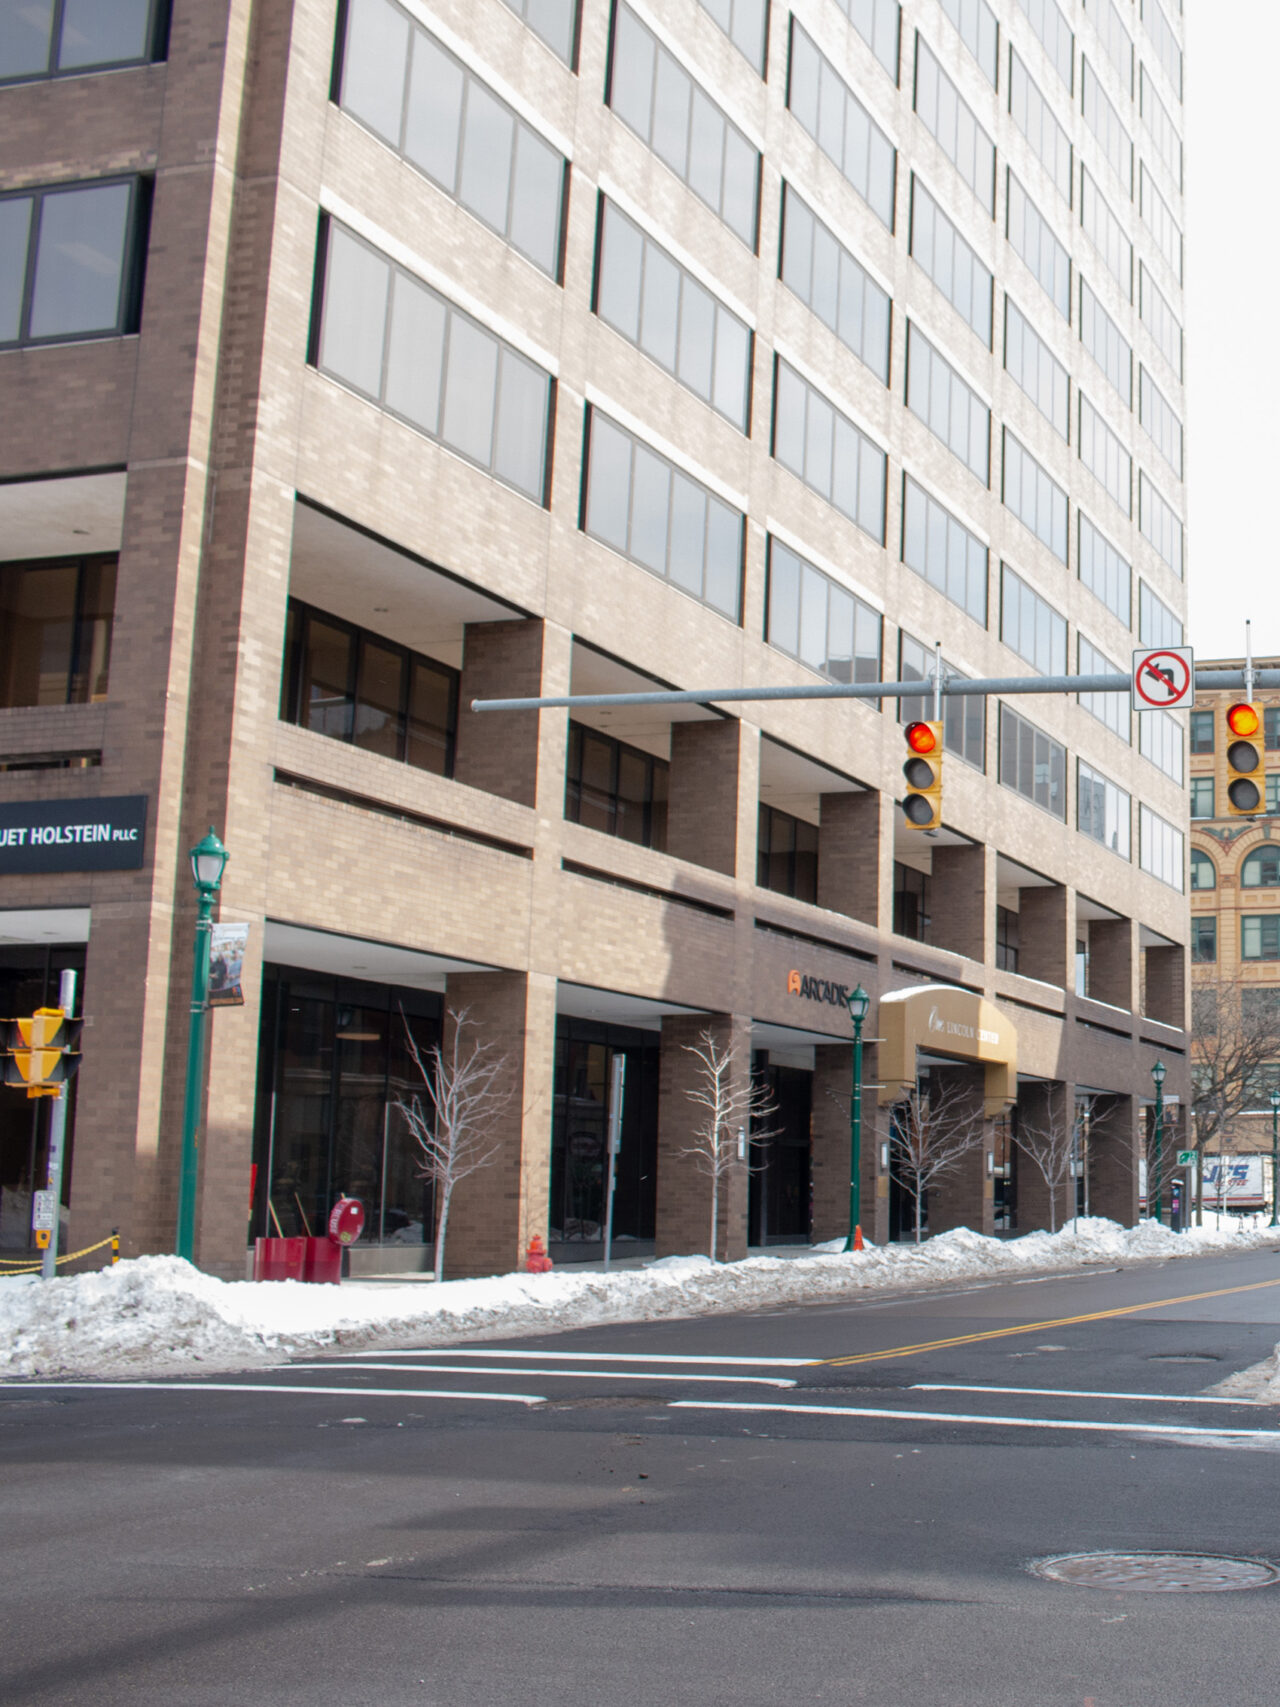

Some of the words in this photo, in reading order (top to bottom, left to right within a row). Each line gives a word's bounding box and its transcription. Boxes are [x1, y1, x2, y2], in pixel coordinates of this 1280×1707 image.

[30, 823, 111, 846] HOLSTEIN
[112, 828, 139, 841] PLLC
[799, 974, 849, 1009] ARCADIS
